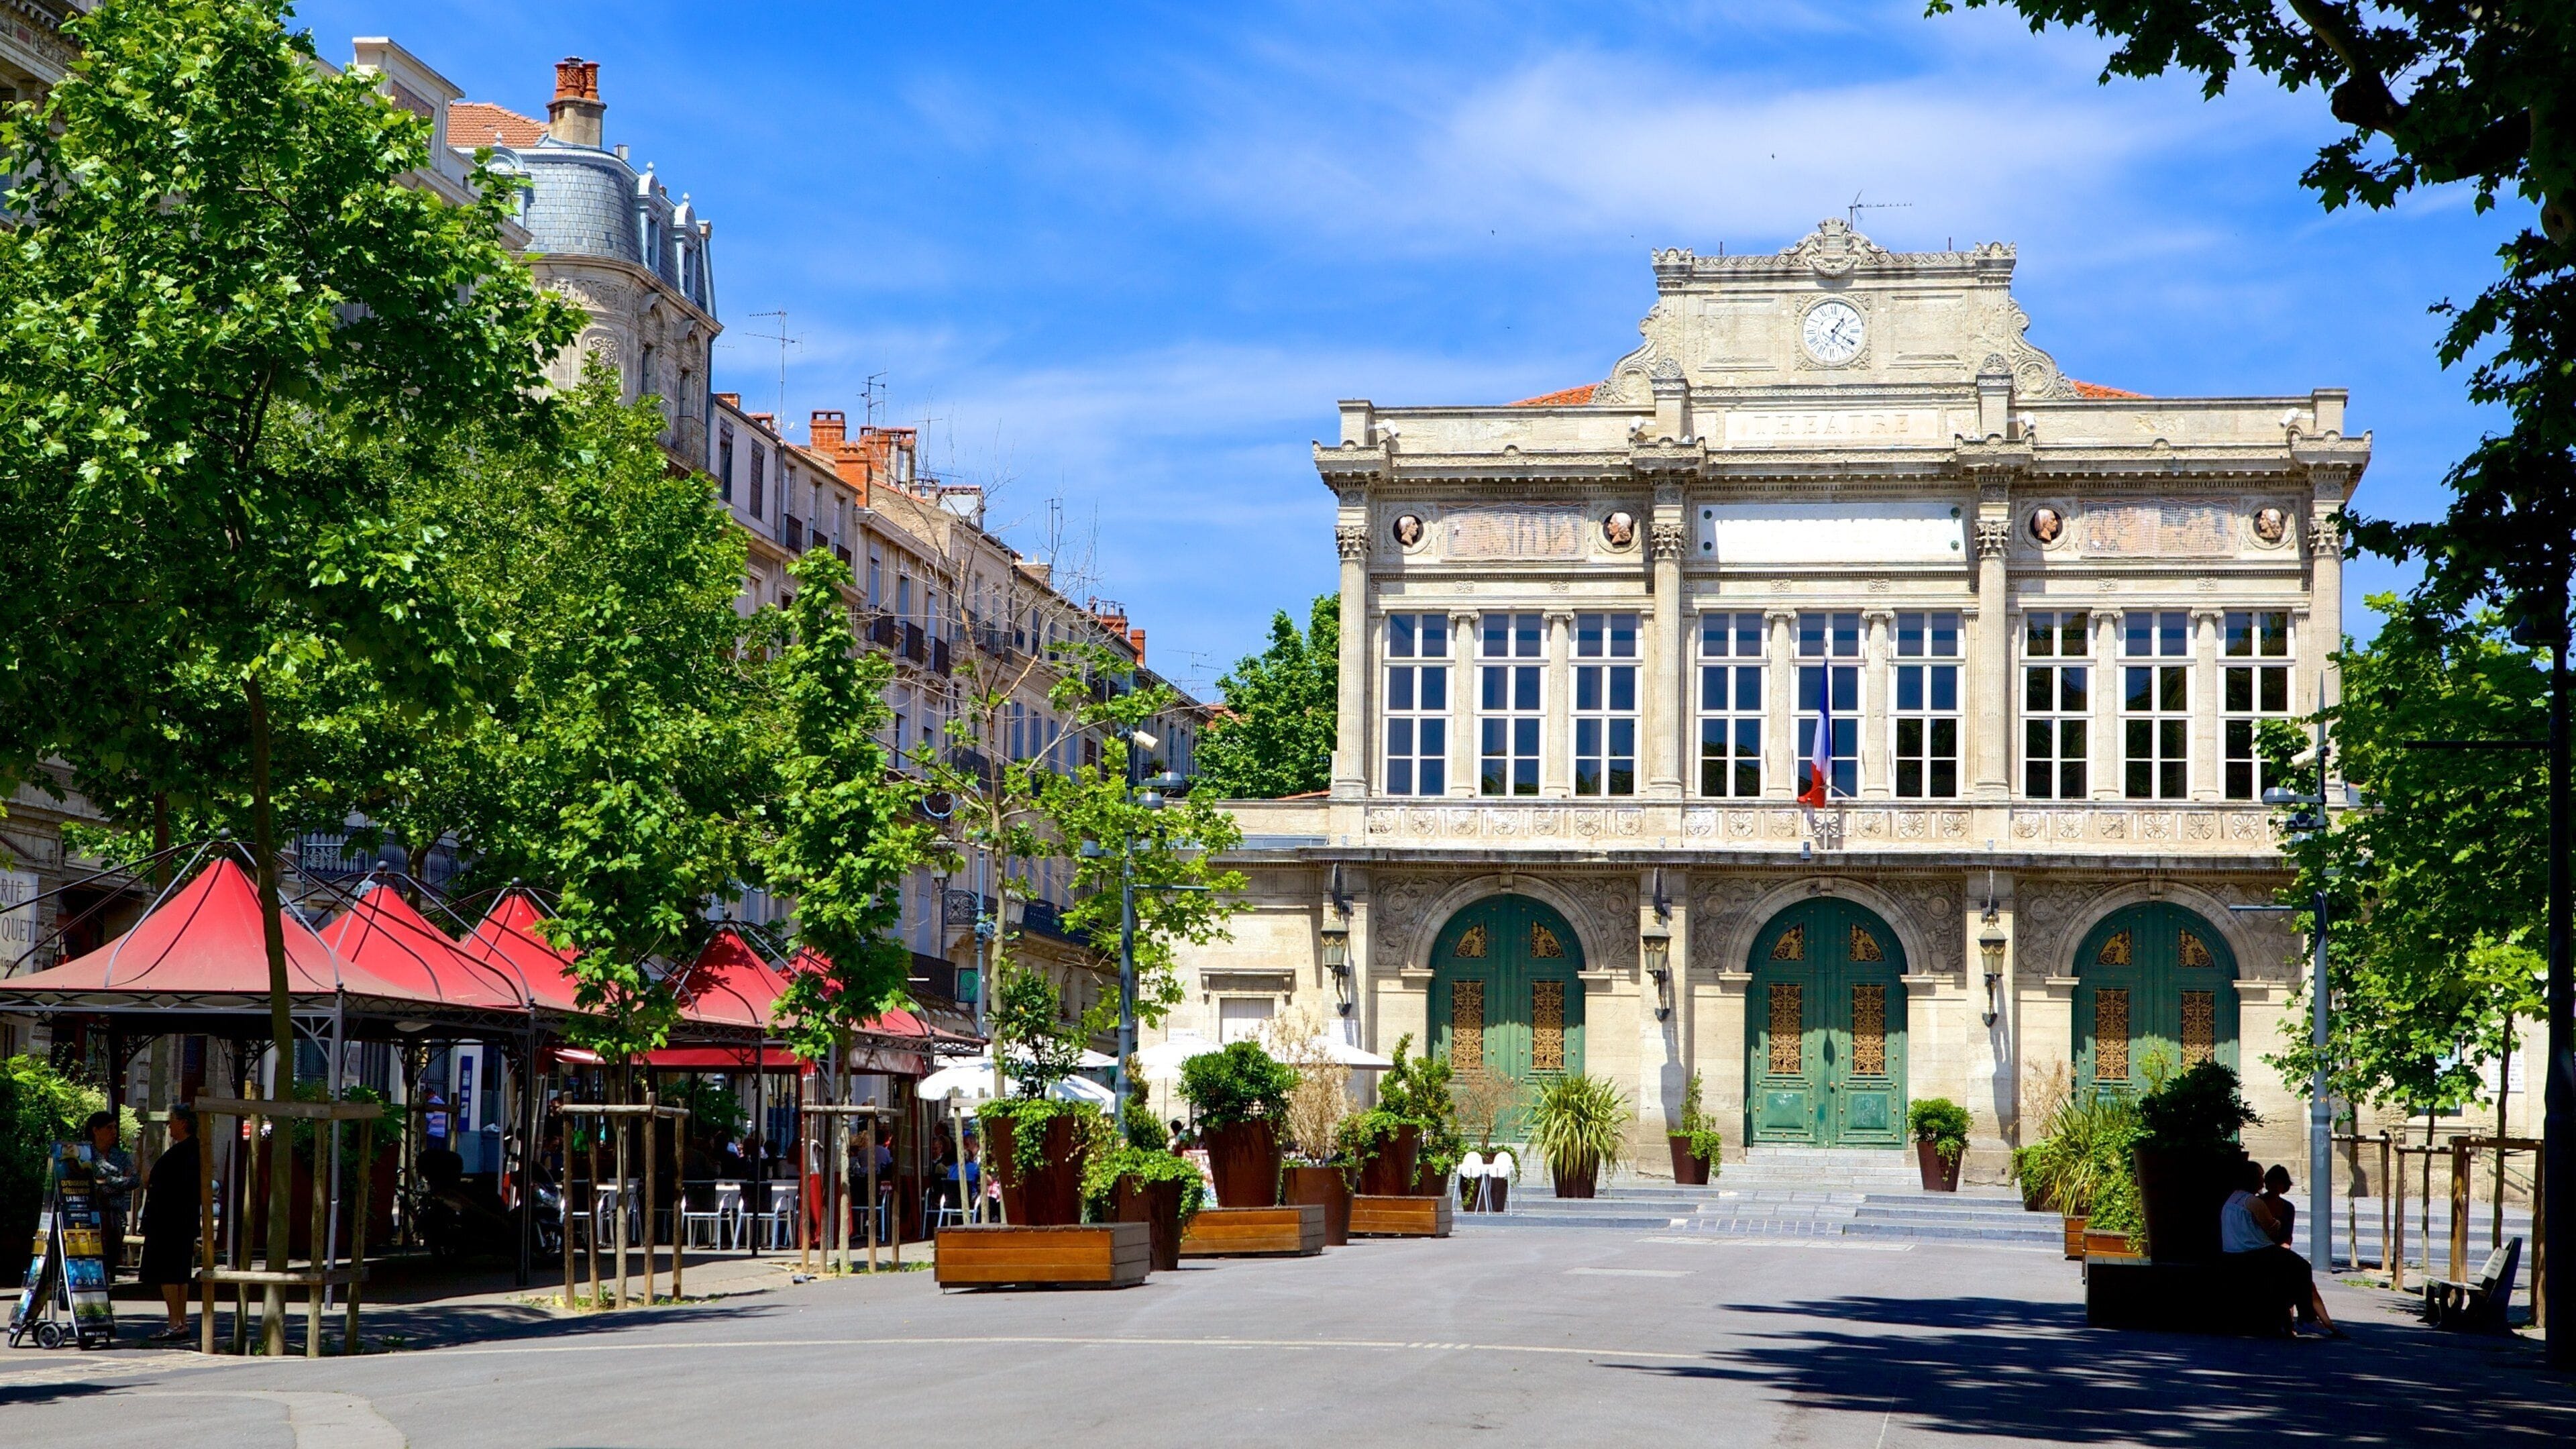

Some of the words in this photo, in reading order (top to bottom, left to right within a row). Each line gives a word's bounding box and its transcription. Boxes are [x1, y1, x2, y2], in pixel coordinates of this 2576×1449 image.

[1754, 415, 1910, 435] THEATRE
[1, 878, 23, 903] RIE
[2, 917, 34, 943] QUET
